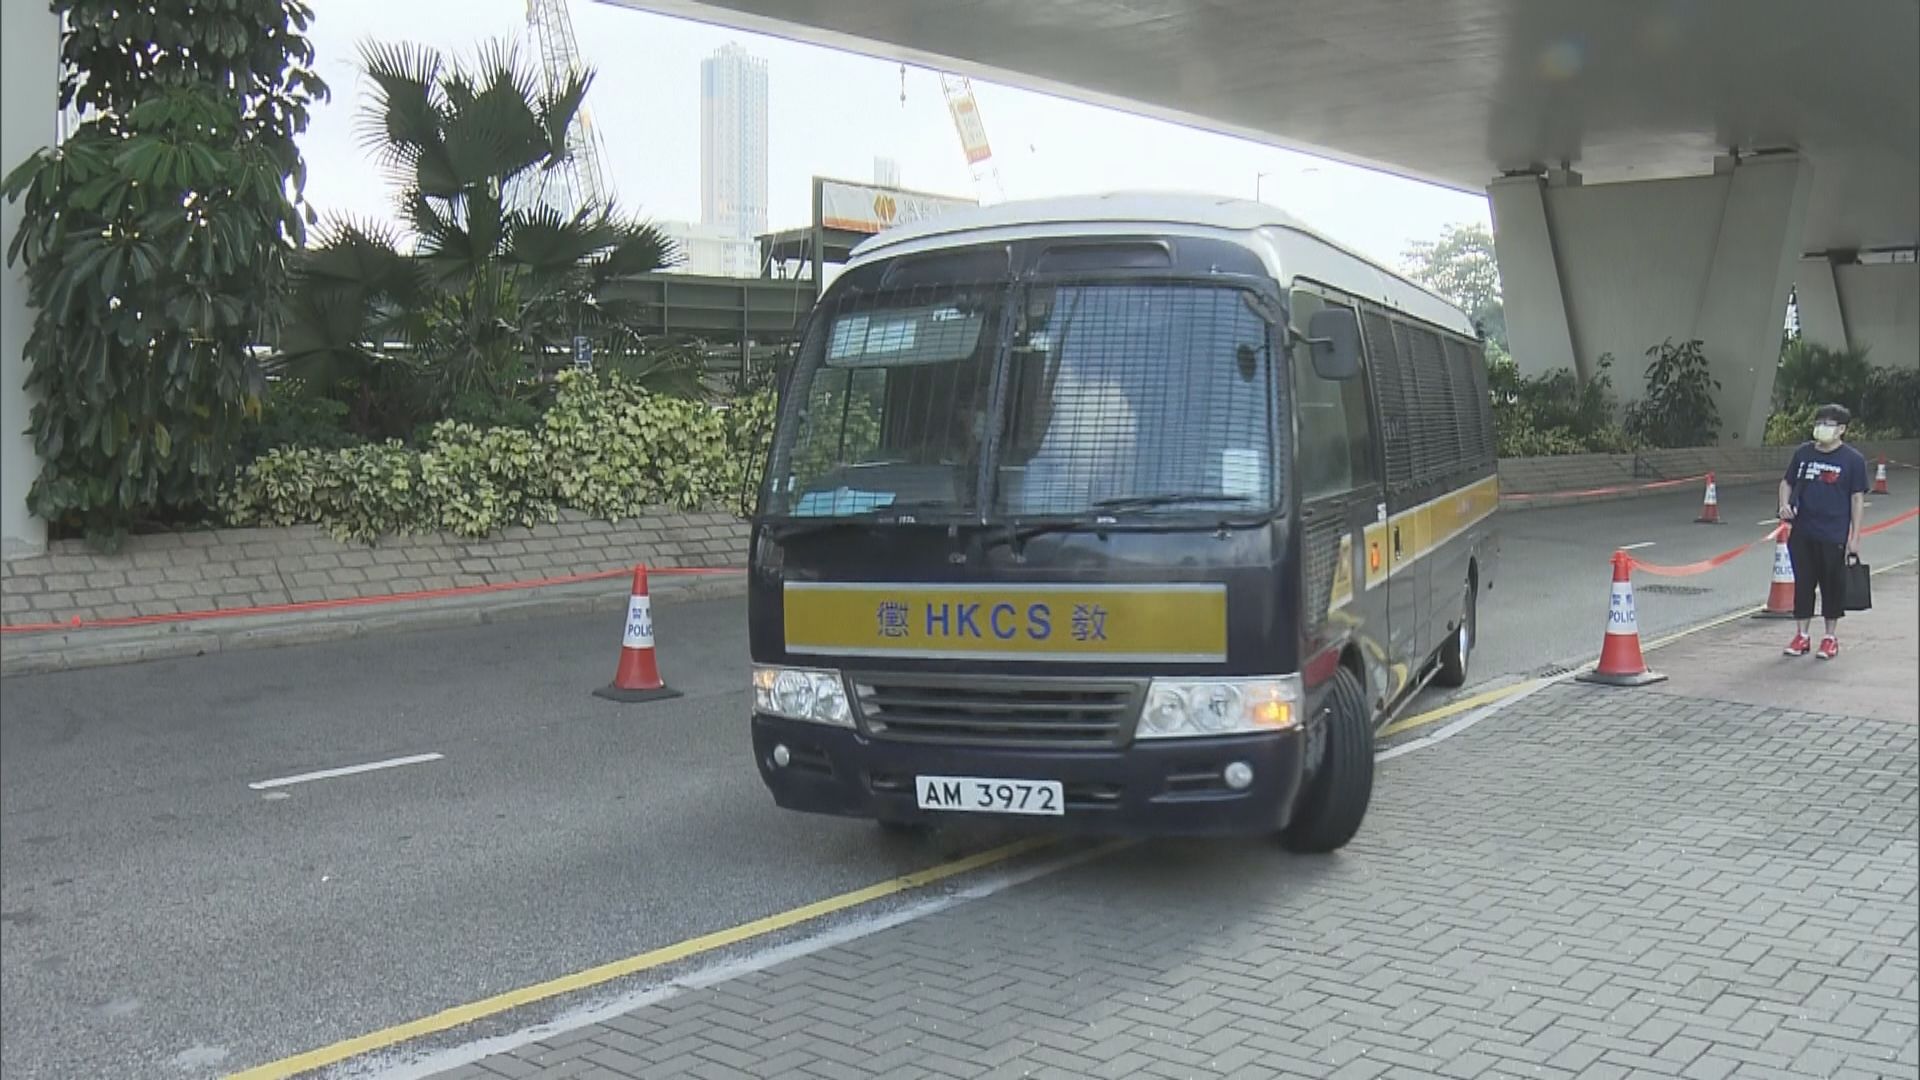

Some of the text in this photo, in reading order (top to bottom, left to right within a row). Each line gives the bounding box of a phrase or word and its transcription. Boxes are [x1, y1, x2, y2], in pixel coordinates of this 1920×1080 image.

[926, 603, 1052, 639] HKCS
[925, 781, 1056, 811] AM 3972
